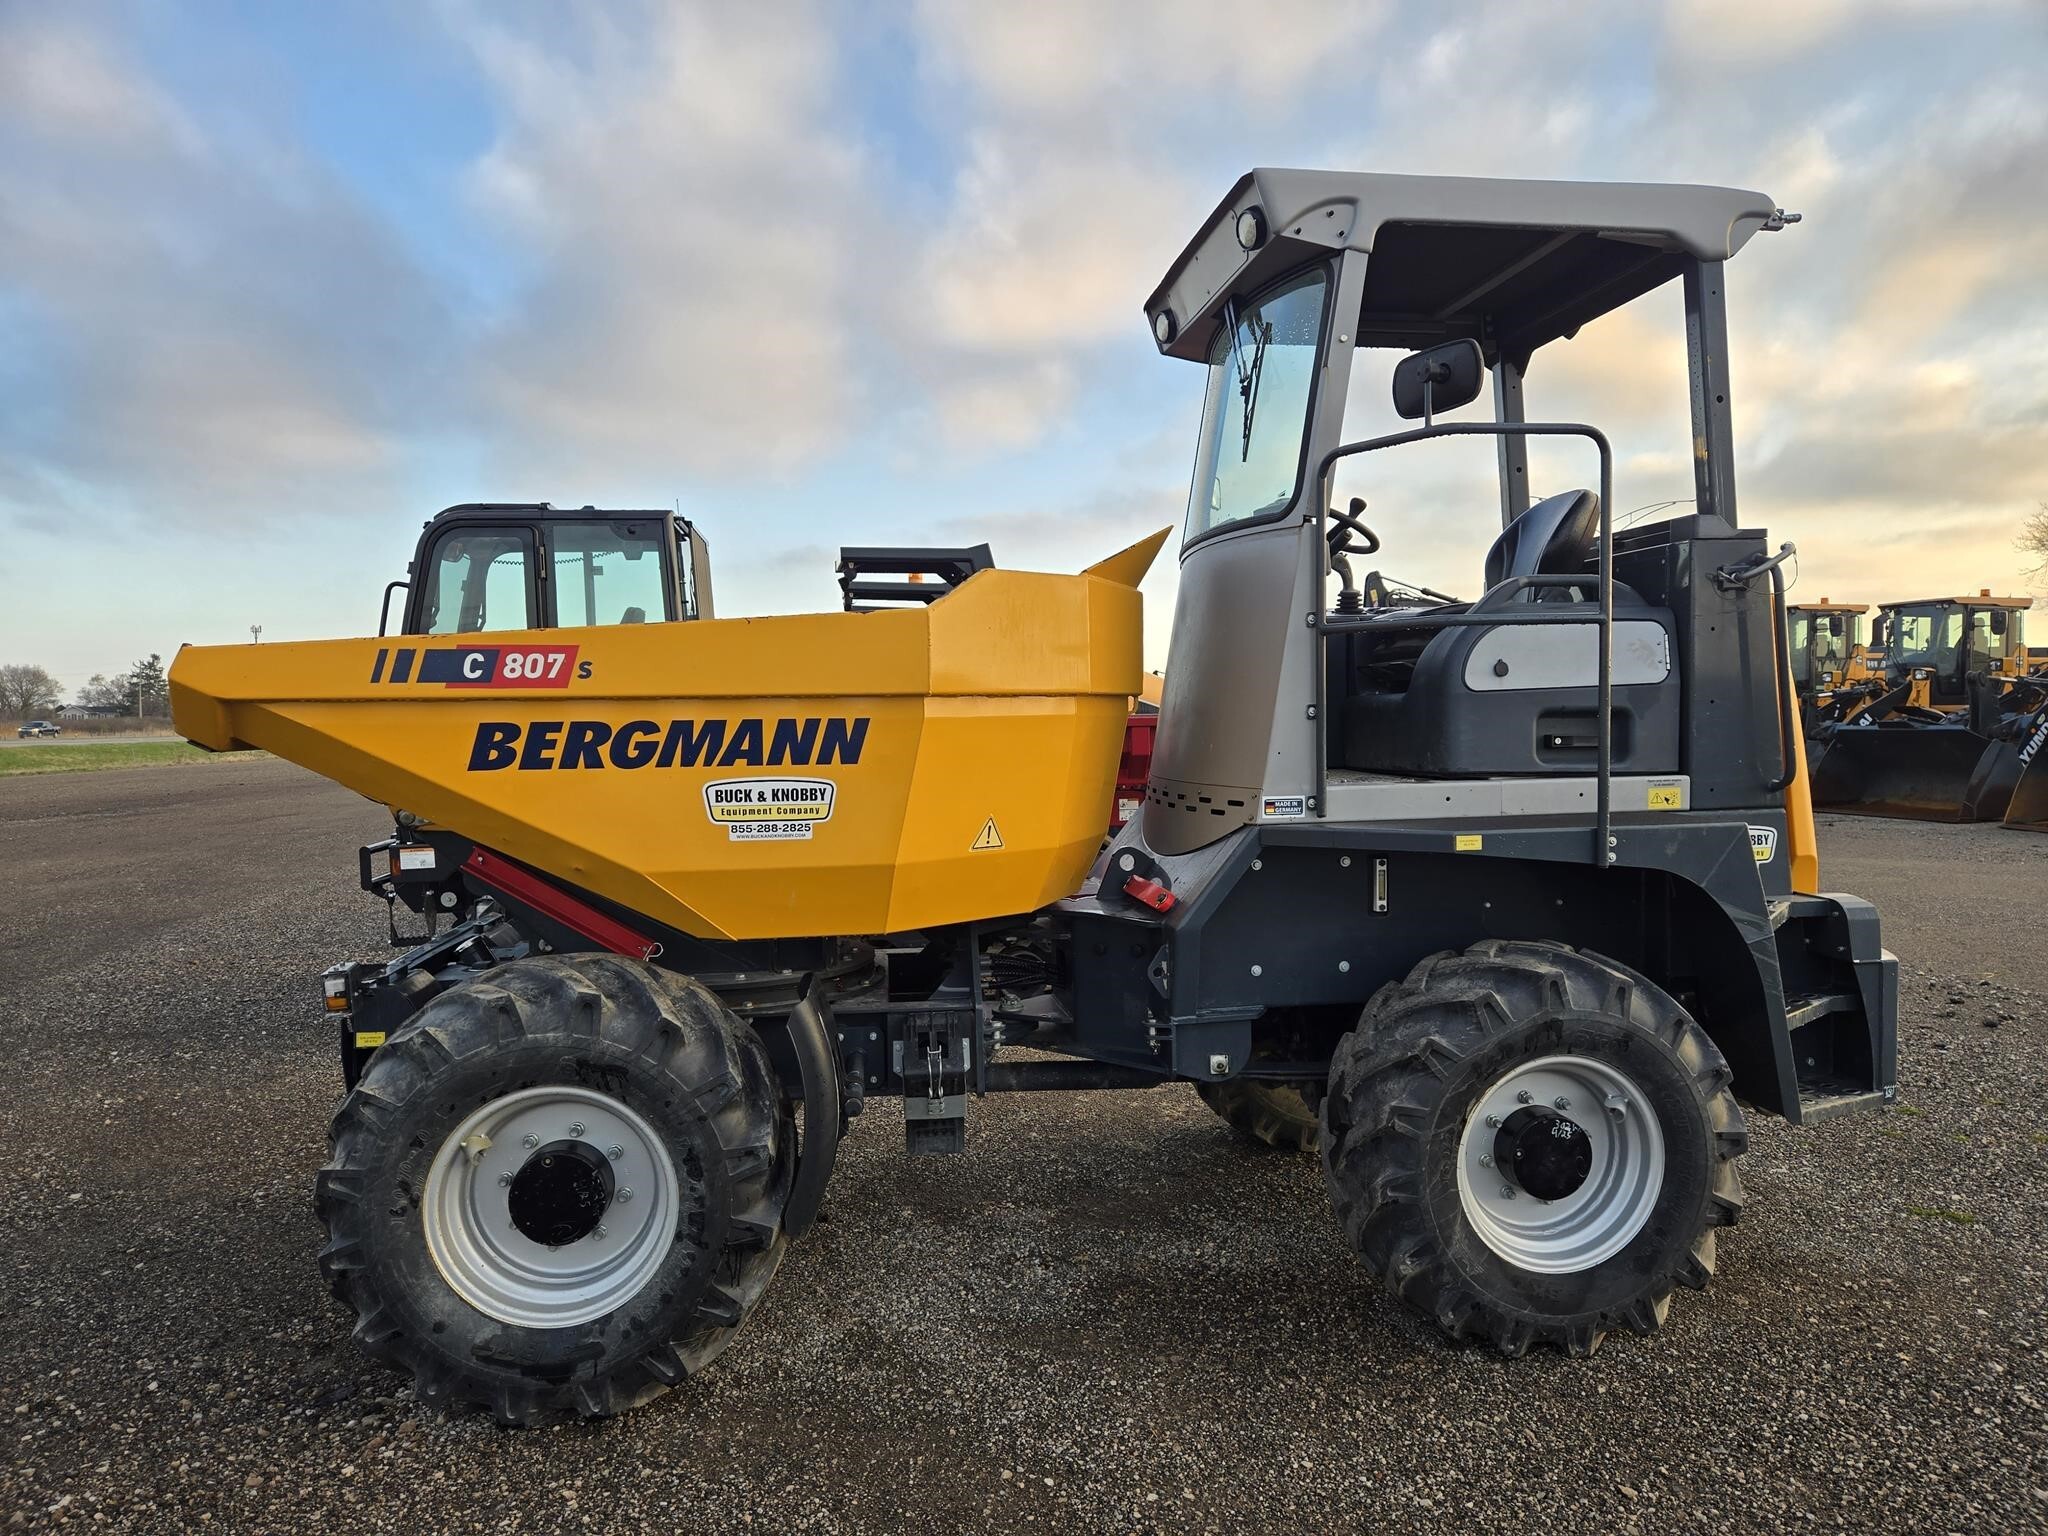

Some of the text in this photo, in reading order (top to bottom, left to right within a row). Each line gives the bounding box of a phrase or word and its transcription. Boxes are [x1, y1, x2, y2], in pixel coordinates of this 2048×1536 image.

[463, 652, 485, 679] C
[503, 653, 566, 679] 807
[467, 717, 871, 772] BERGMANN
[714, 788, 827, 803] BUCK & KNOBBY
[721, 806, 820, 816] Equipment Company
[731, 823, 811, 833] 855-288-2825
